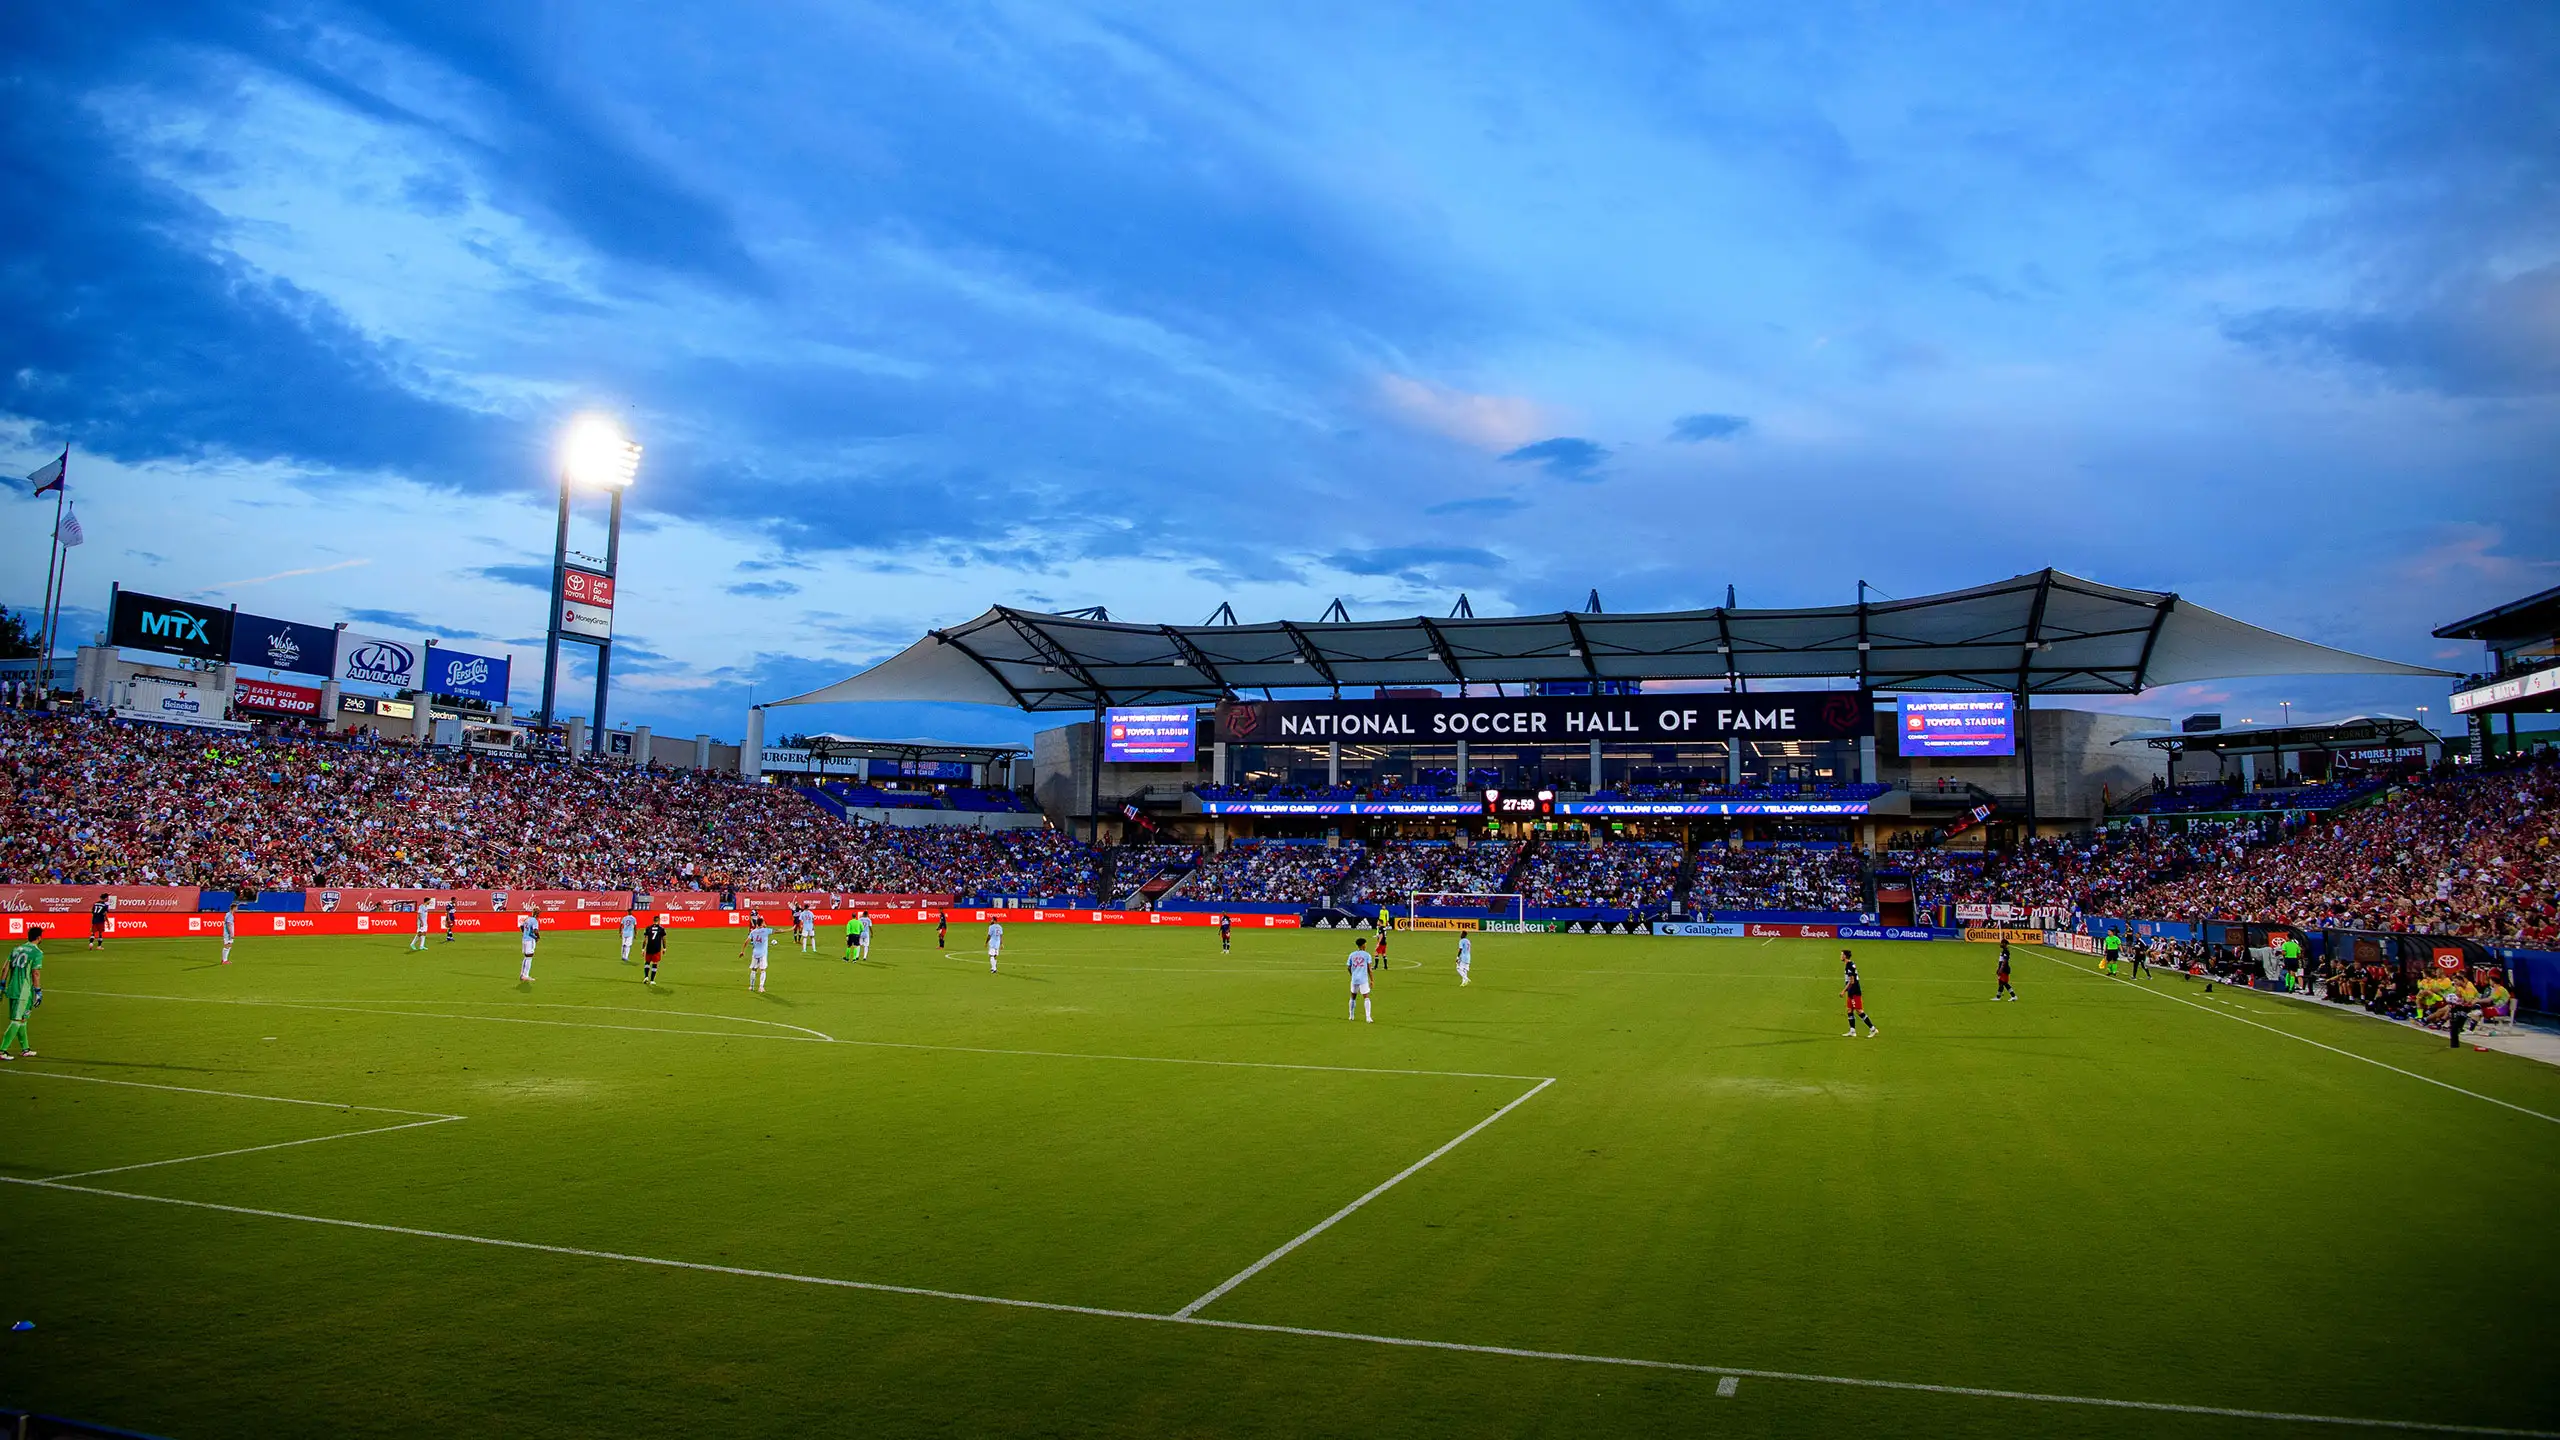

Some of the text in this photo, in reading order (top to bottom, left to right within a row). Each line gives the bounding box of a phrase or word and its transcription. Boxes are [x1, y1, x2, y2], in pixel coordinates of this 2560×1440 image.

[593, 580, 608, 589] Let's
[565, 590, 585, 599] TOYOTA
[593, 595, 612, 605] Places
[575, 614, 608, 626] MoneyGram
[141, 610, 210, 645] MTX
[347, 667, 411, 686] ADVOCARE
[251, 686, 275, 696] EAST
[277, 690, 297, 699] SIDE
[454, 687, 468, 695] SINCE
[164, 700, 198, 711] Heineken
[248, 695, 314, 711] FAN SHOP
[1907, 703, 1926, 711] PLAN
[429, 710, 458, 721] Spectrum
[1281, 708, 1796, 735] NATIONAL SOCCER HALL OF FAME
[1926, 718, 2006, 727] TOYOTA STADIUM
[1127, 728, 1154, 736] TOYOTA
[760, 751, 809, 764] BURGERS
[2358, 749, 2385, 759] MORE
[1489, 803, 1496, 812] 1
[1502, 799, 1535, 810] 27:59
[1542, 803, 1550, 812] 0
[1607, 805, 1683, 813] YELLOW CARD
[1762, 804, 1841, 813] YELLOW CARD
[118, 899, 146, 907] TOYOTA
[94, 905, 102, 914] 17
[1957, 905, 1983, 913] DALLAS
[2011, 907, 2027, 920] EL
[26, 921, 55, 929] TOYOTA
[117, 921, 147, 929] TOYOTA
[1397, 918, 1447, 930] Continental
[1485, 920, 1545, 932] Heineken
[651, 931, 657, 940] 7
[1684, 925, 1733, 936] Gallagher
[1853, 928, 1881, 937] Allstate
[1900, 929, 1928, 939] Allstate
[1966, 929, 2013, 941] Continental
[2023, 932, 2041, 940] TIRE
